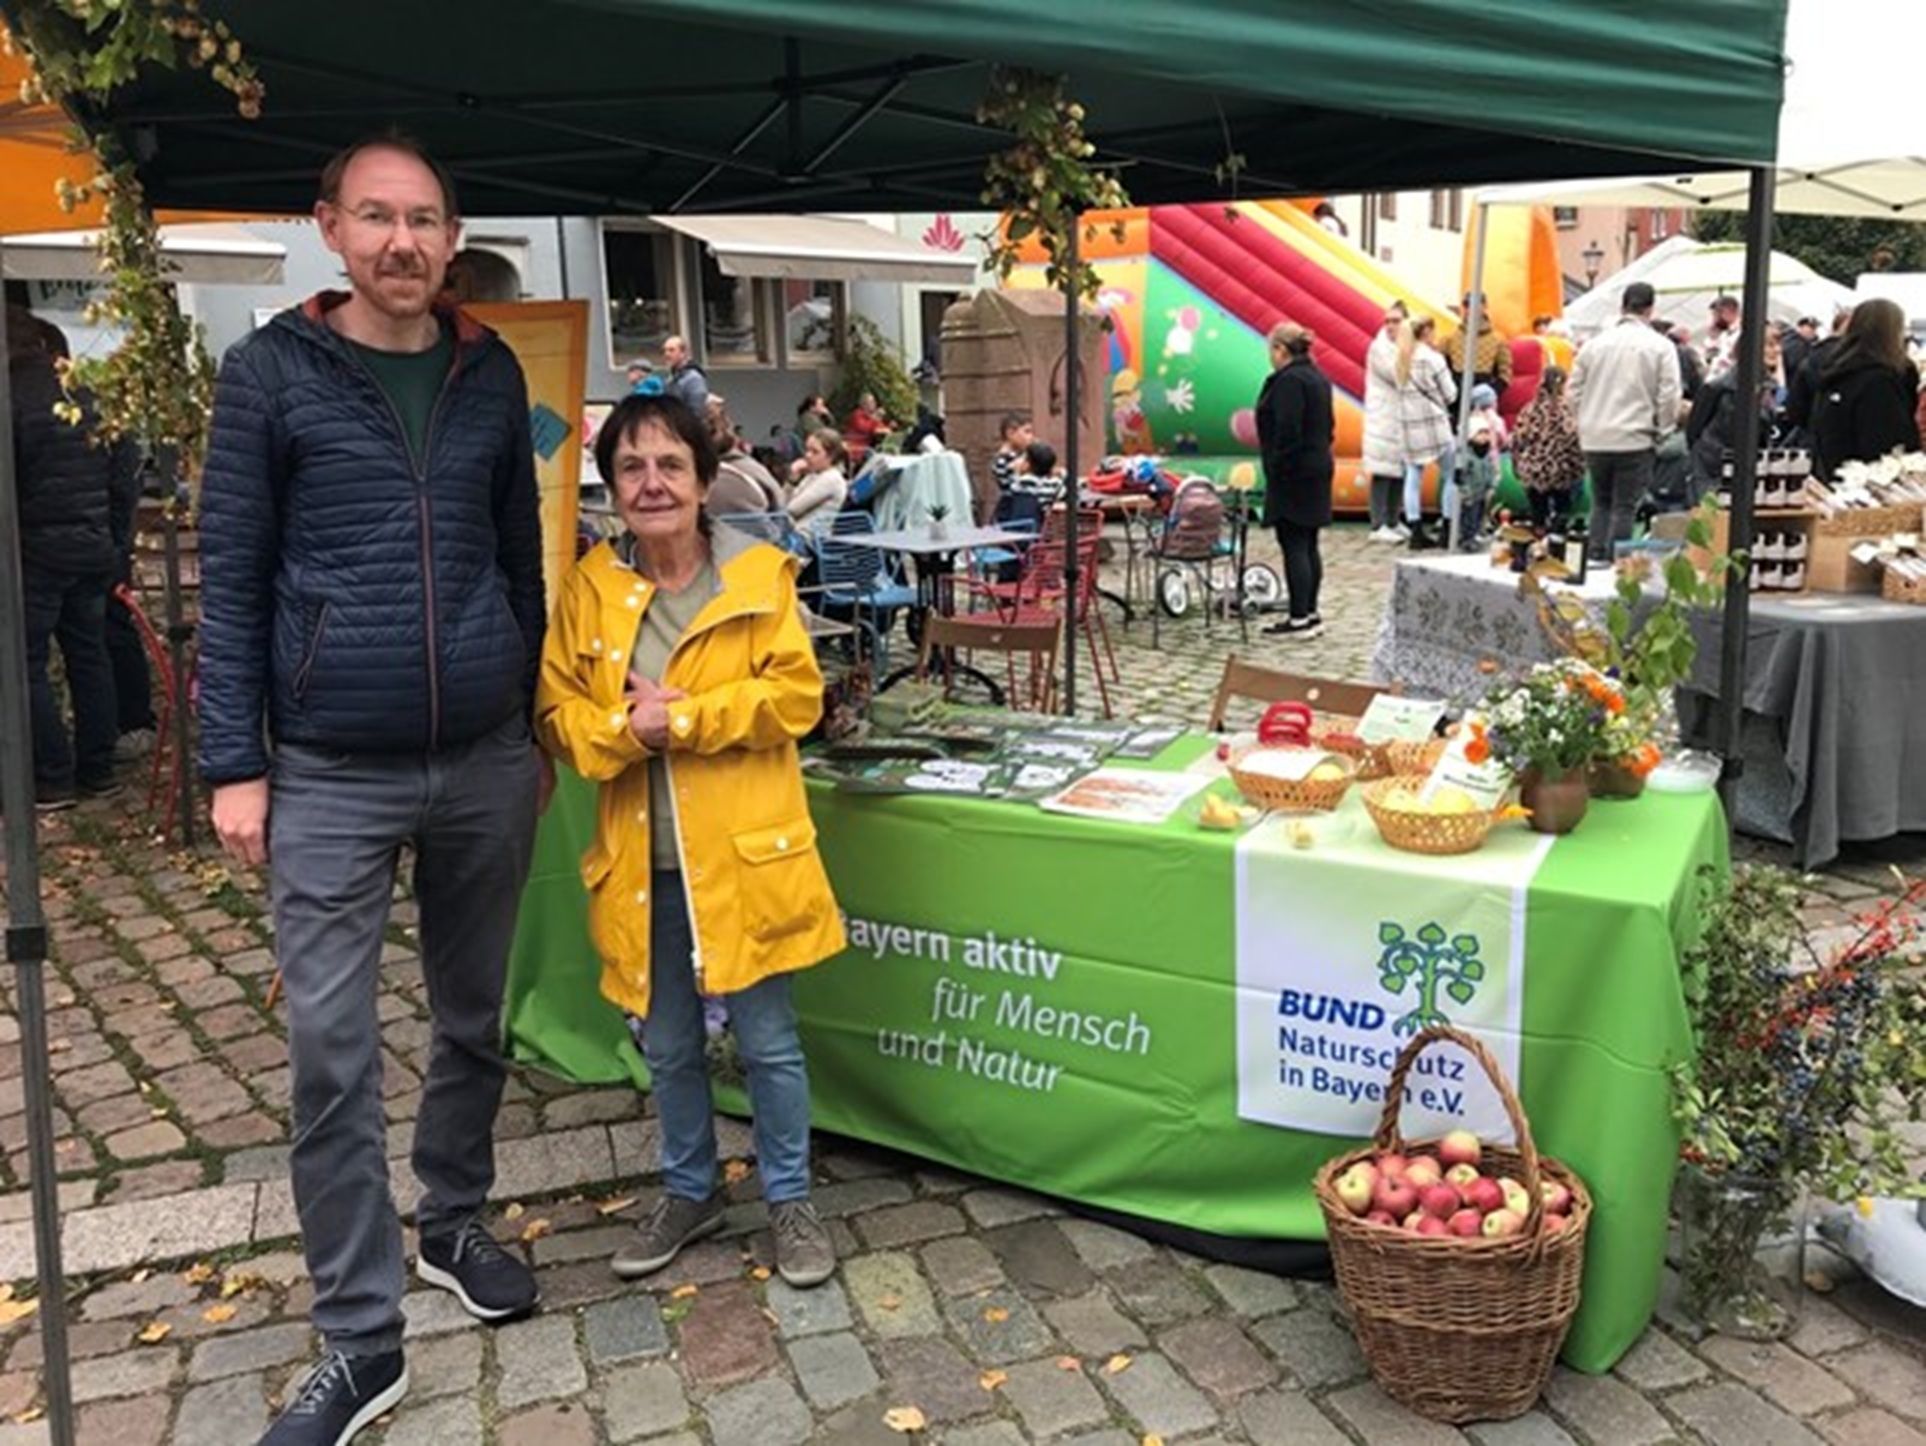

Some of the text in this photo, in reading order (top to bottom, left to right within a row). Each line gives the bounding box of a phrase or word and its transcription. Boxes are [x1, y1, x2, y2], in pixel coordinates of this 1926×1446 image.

[963, 931, 1061, 980] aktiv
[932, 977, 1150, 1055] für Mensch
[1278, 989, 1385, 1031] BUND
[877, 1028, 1061, 1091] und Natur
[1280, 1060, 1303, 1087] in
[1421, 1088, 1464, 1116] e.V.
